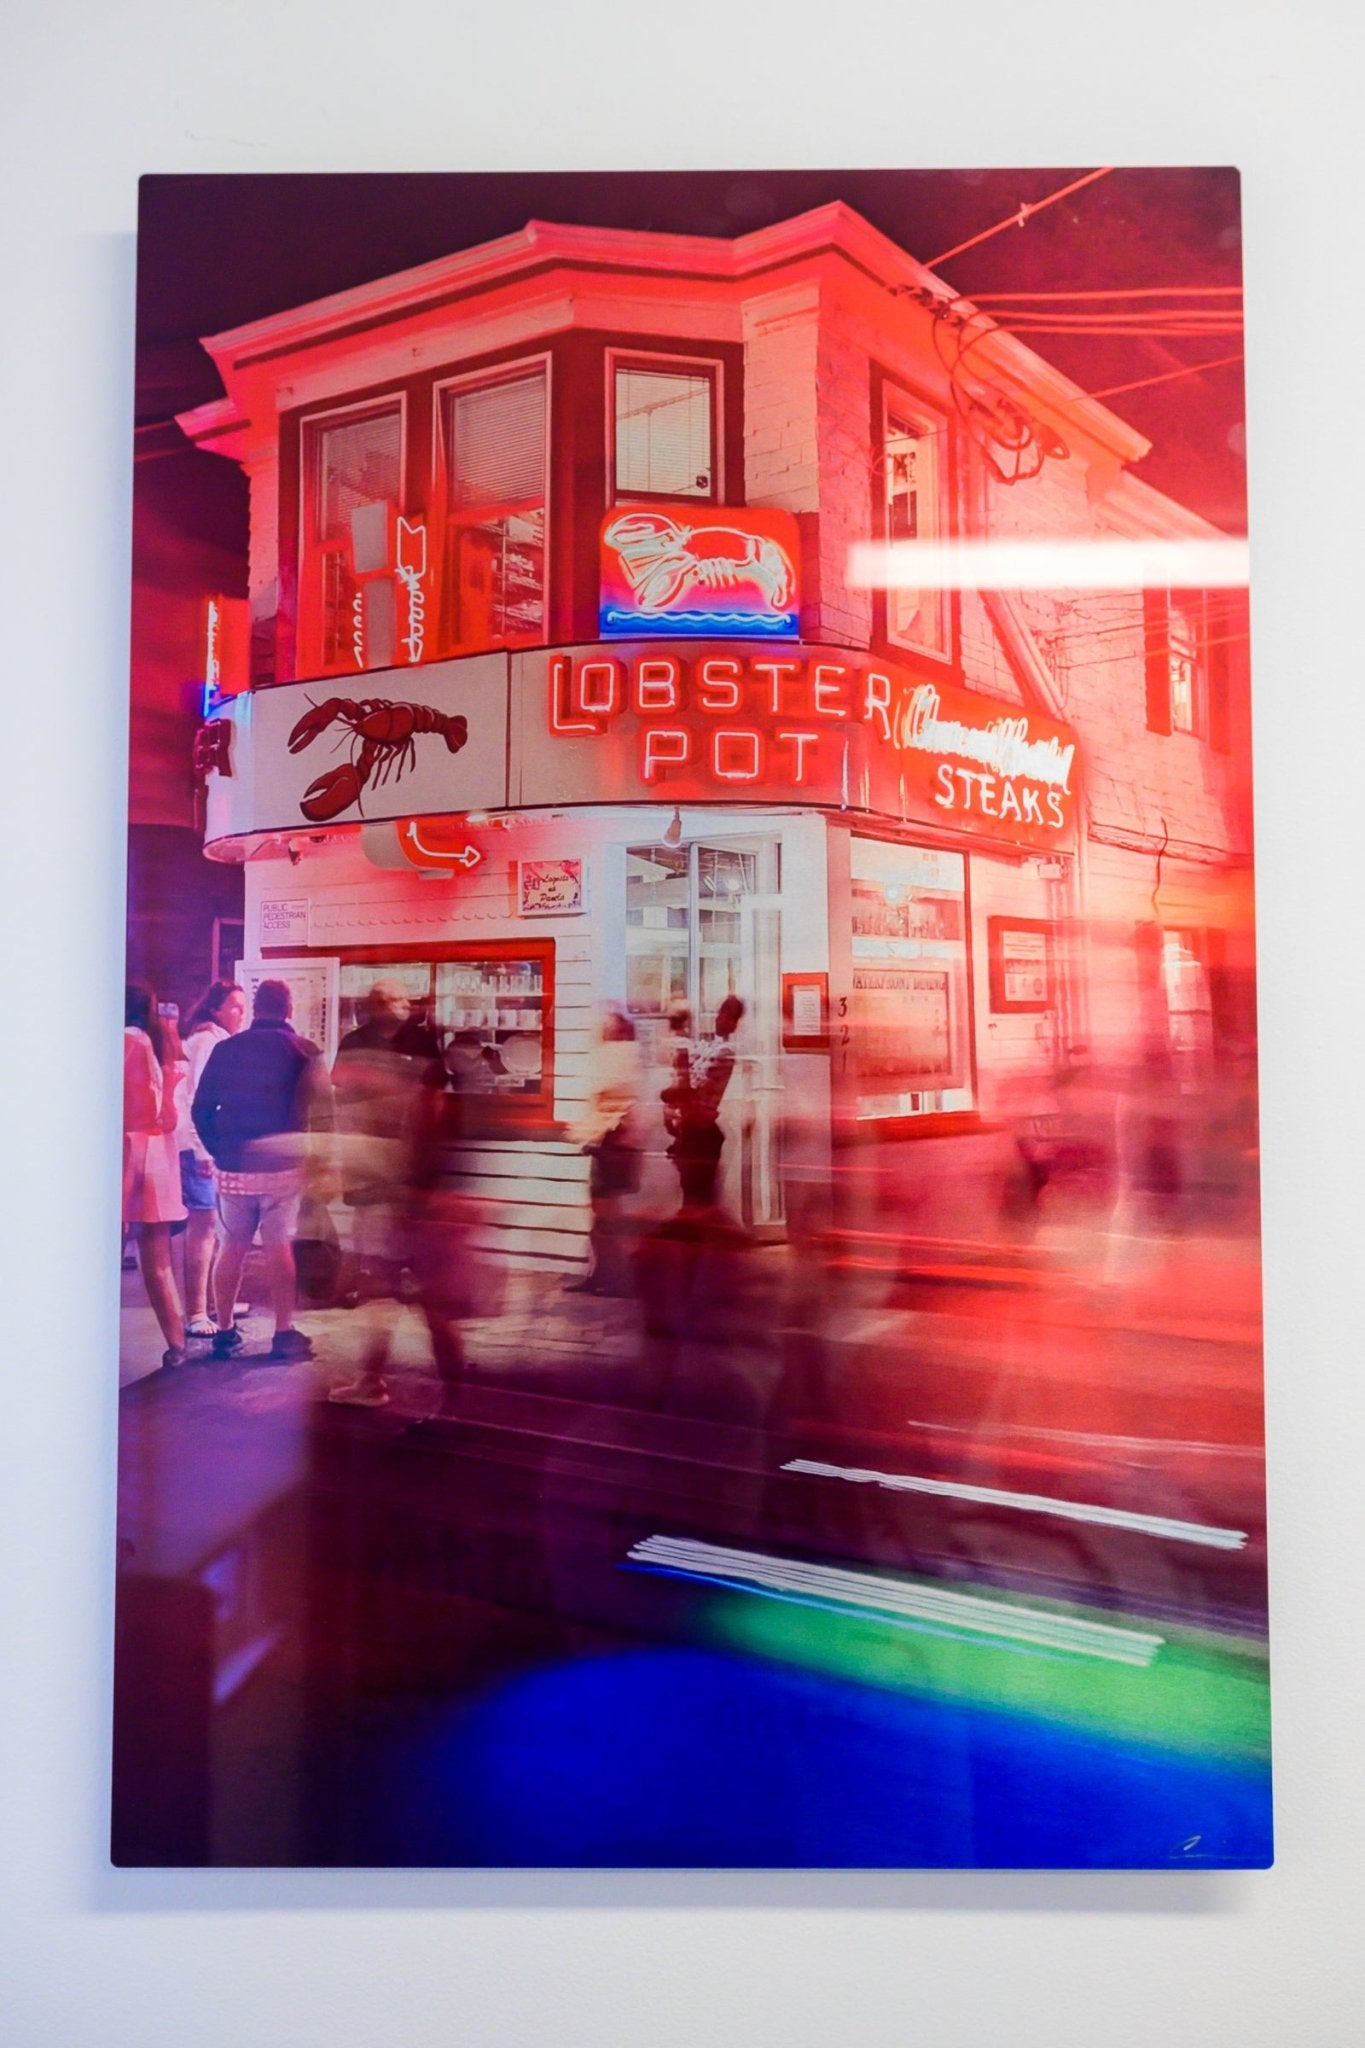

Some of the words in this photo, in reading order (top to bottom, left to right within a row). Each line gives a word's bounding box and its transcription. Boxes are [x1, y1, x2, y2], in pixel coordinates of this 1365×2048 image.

[550, 658, 891, 741] LOBSTER
[643, 729, 819, 783] POT
[934, 763, 1065, 829] STEAKS
[263, 903, 288, 912] PUBLIC
[263, 911, 307, 921] PEDESTRIAN
[263, 920, 291, 929] ACCESS
